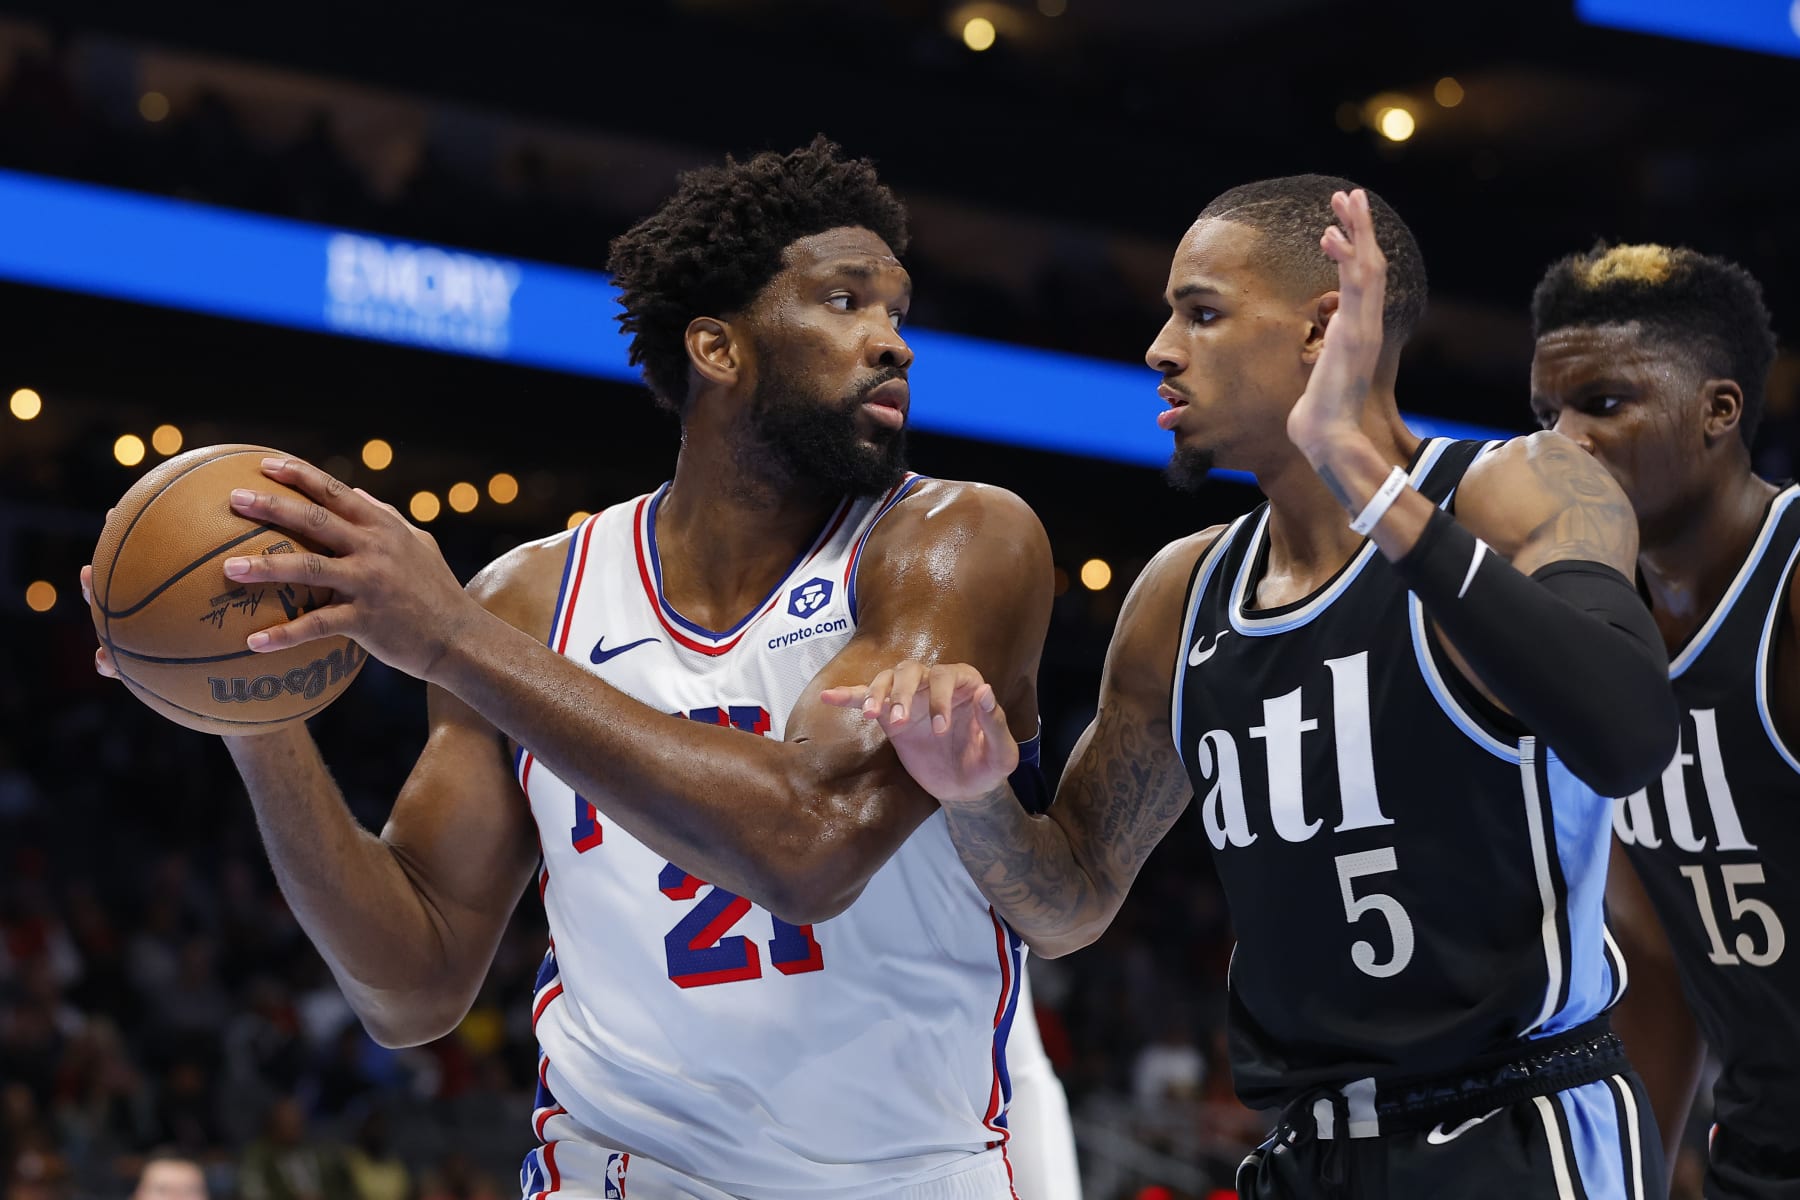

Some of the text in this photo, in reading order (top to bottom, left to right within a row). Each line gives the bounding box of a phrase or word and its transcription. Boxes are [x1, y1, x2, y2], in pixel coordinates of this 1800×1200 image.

[768, 618, 847, 649] crypto.com
[1199, 650, 1395, 850] atl
[1334, 846, 1415, 978] 5
[1679, 863, 1786, 967] 15
